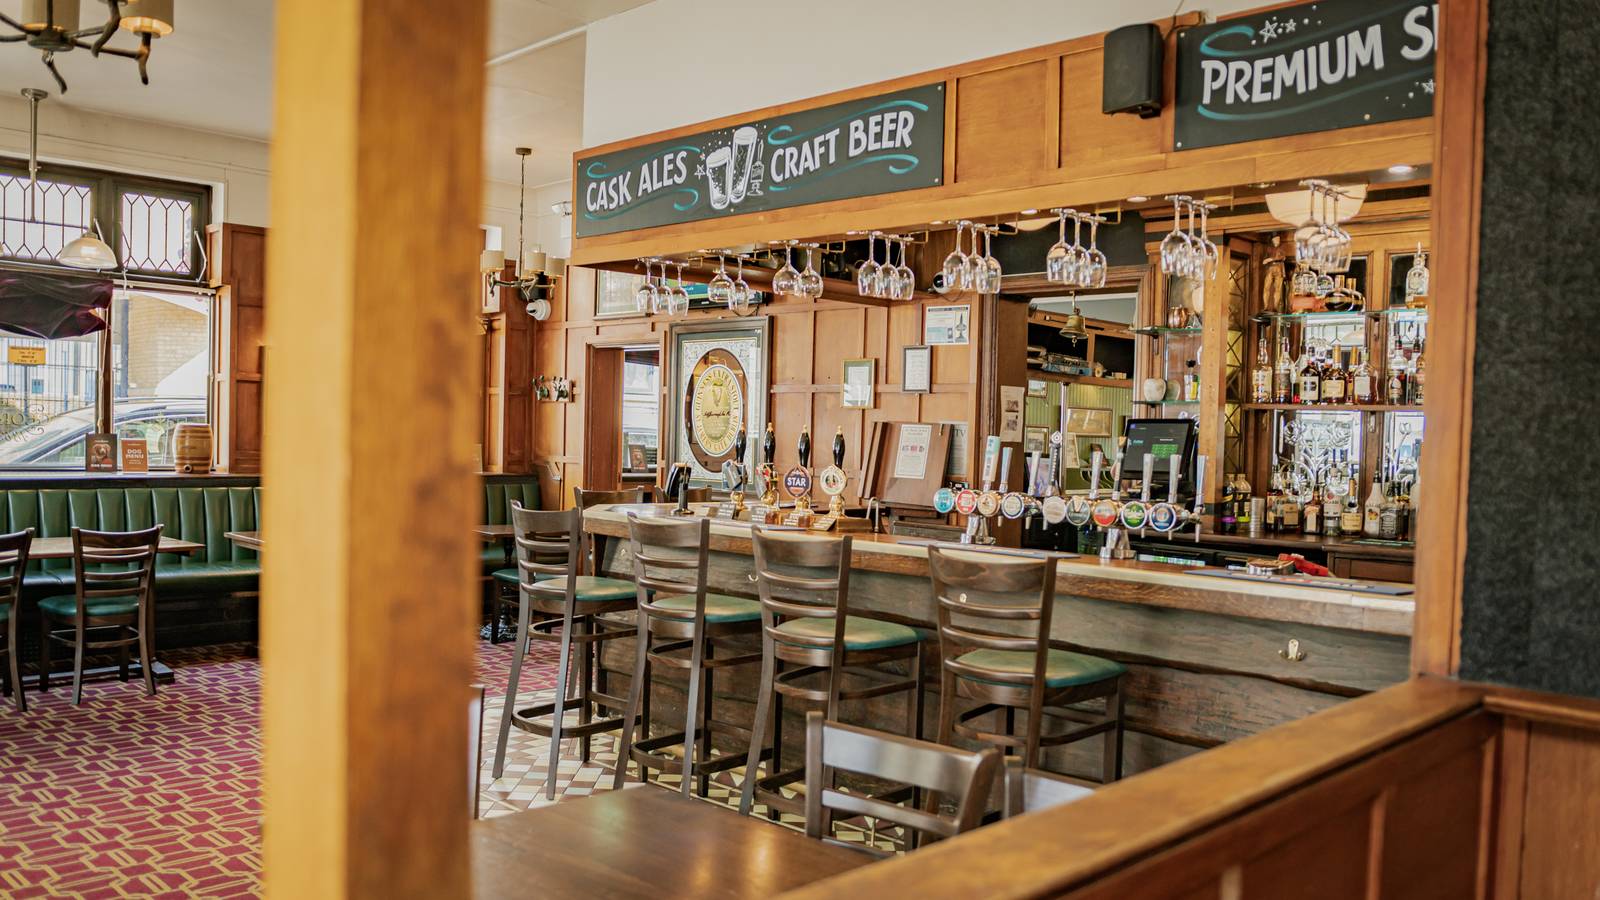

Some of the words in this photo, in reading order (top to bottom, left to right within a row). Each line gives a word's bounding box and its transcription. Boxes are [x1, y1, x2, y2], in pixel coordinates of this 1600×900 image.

[1201, 24, 1385, 105] PREMIUM
[1400, 4, 1439, 61] S
[586, 172, 632, 212] CASK
[638, 150, 688, 200] ALES
[770, 128, 840, 184] CRAFT
[847, 110, 915, 158] BEER
[787, 477, 806, 487] STAR
